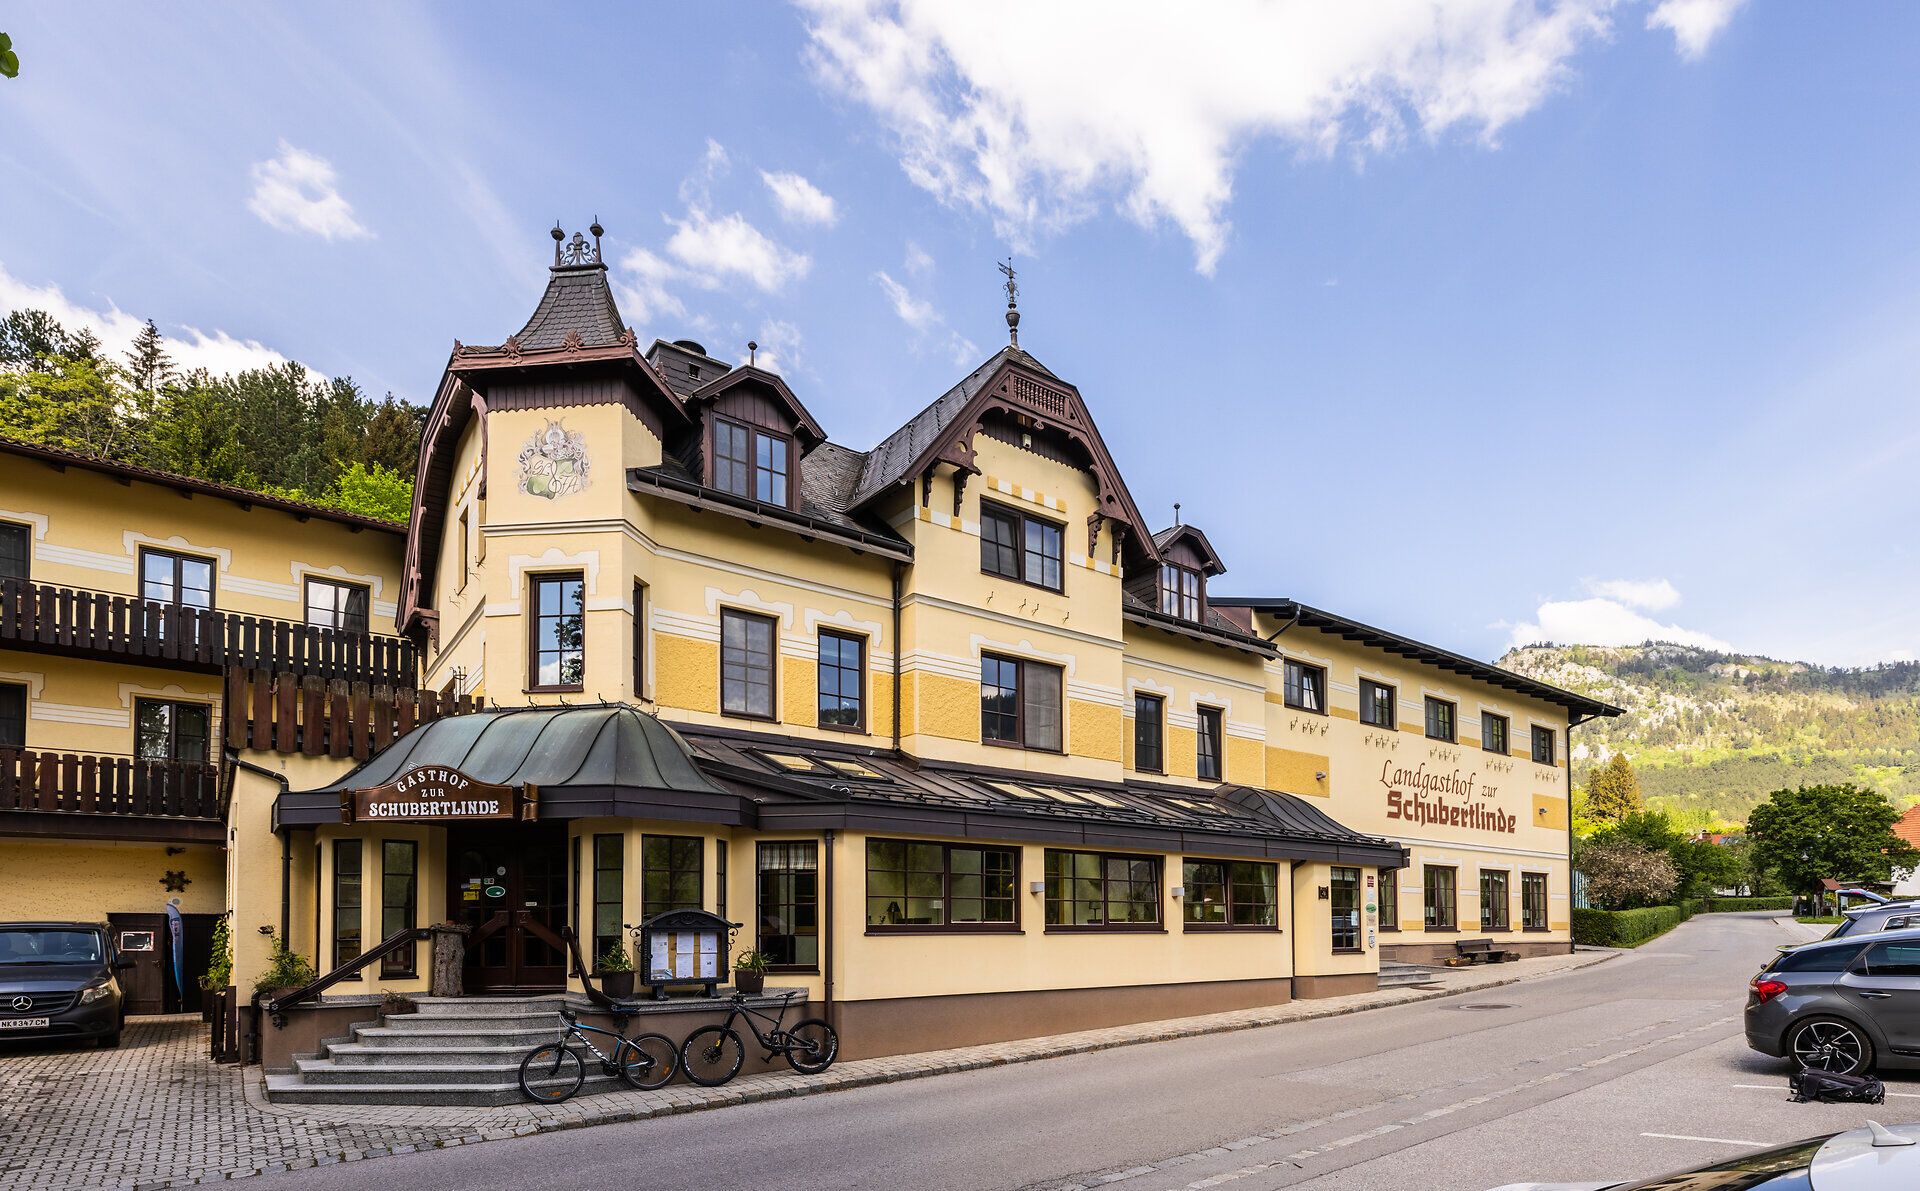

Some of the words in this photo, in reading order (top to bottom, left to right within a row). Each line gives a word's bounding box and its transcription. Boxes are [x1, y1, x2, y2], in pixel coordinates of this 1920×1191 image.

[397, 769, 469, 793] GASTHOF
[421, 788, 445, 798] ZUR
[1379, 759, 1477, 804] Landgasthof
[1481, 784, 1498, 798] zur
[368, 800, 499, 817] SCHUBERTLINDE
[1386, 790, 1517, 834] Schubertlinde
